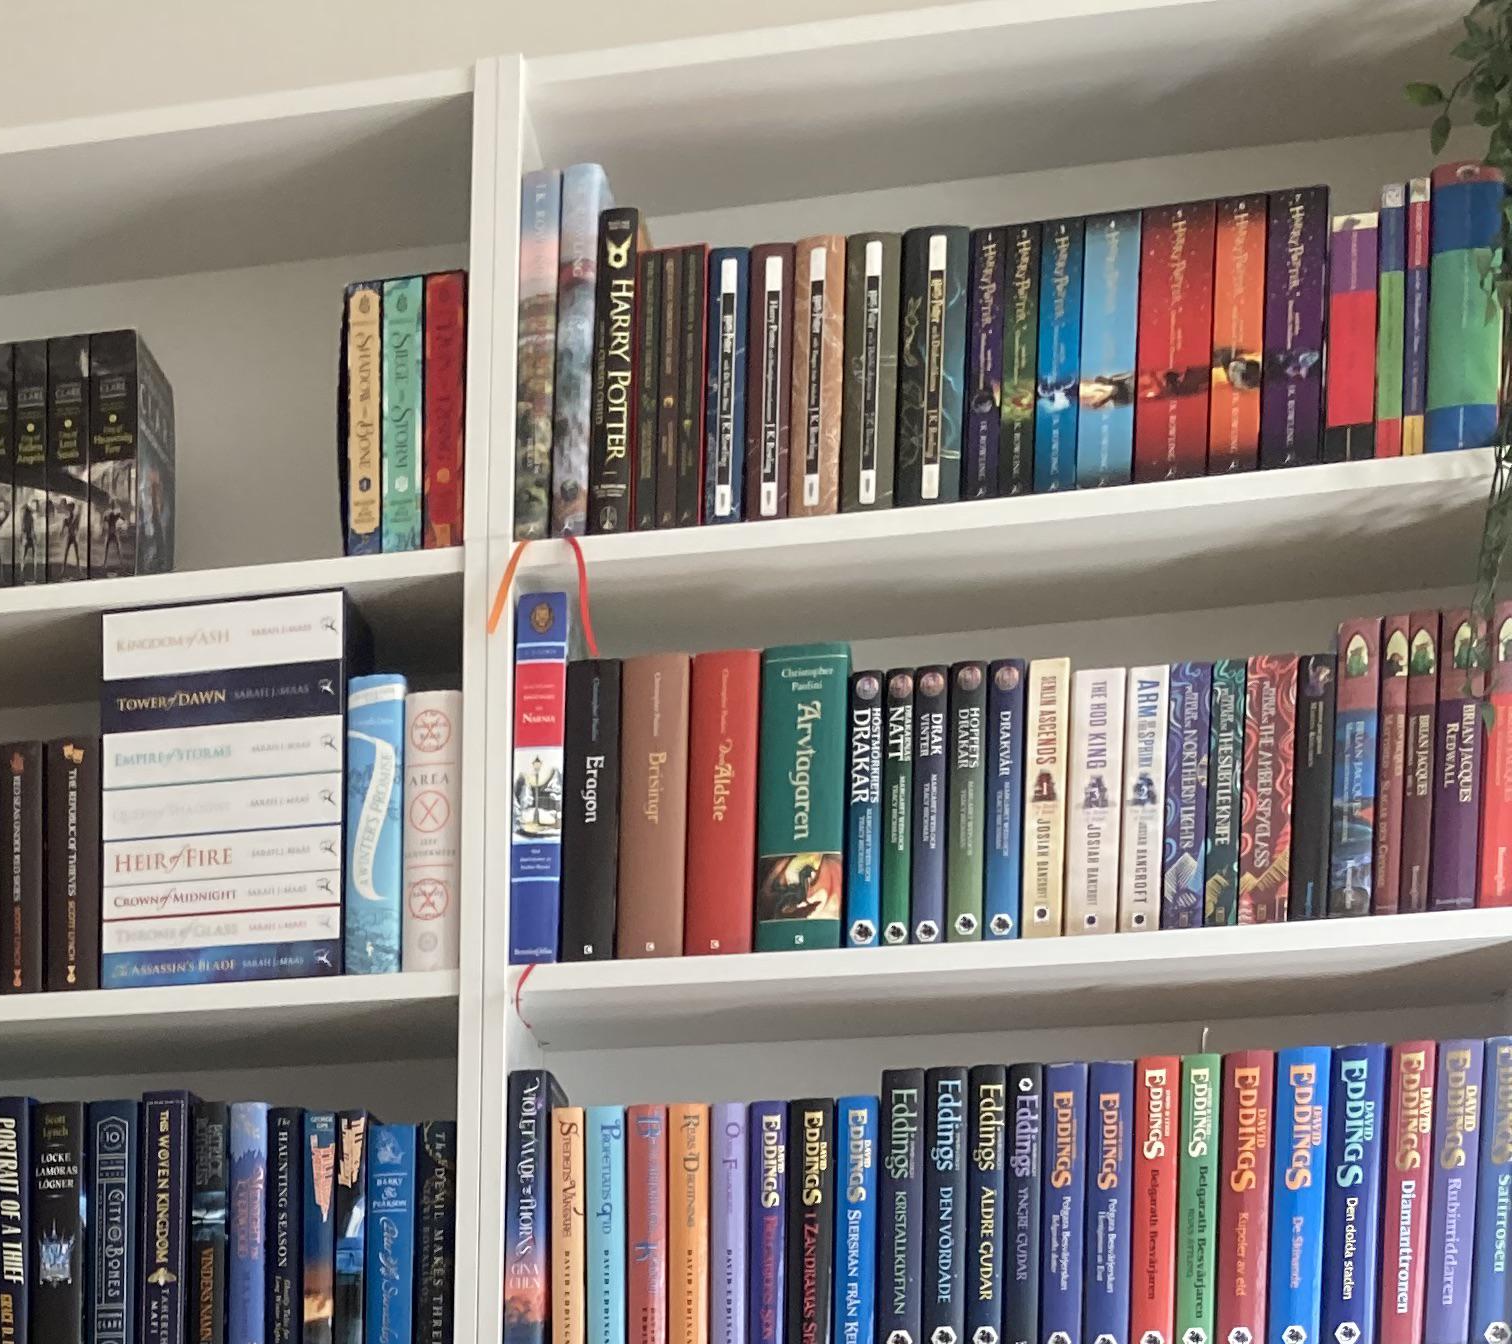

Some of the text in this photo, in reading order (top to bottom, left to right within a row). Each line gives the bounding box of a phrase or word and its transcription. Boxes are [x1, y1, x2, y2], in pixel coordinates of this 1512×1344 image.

[605, 279, 634, 463] HARRY POTTER
[117, 698, 169, 713] TOWER
[179, 691, 226, 708] DAWN
[888, 707, 903, 762] NATT
[1087, 682, 1107, 771] THE HOD KING
[789, 701, 822, 841] Arvtagaren
[851, 708, 871, 806] DRAKAR
[957, 708, 969, 770] DRAKAR
[968, 708, 980, 770] HOPPETS
[998, 711, 1013, 777] DRAKVÅR
[1036, 711, 1056, 766] ASCENDS
[1443, 723, 1459, 788] REDWALL
[1457, 705, 1476, 803] BRIAN JACQUES
[581, 756, 604, 824] Eragon
[643, 752, 667, 825] Brisingr
[1179, 729, 1197, 849] NORTHERN LIGHTS
[1253, 725, 1273, 869] THE AMBER SPYGLASS
[114, 856, 168, 874] HEIR
[187, 850, 233, 867] FIRE
[846, 1108, 867, 1204] EDDINGS
[931, 1079, 962, 1170] Eddings
[157, 1134, 169, 1190] WOVEN
[974, 1084, 1004, 1300] Eddings ÄLDRE GUDAR
[1337, 1059, 1368, 1300] EDDINGS Den dolda staden
[0, 1200, 19, 1221] OF
[2, 1224, 20, 1235] A
[156, 1192, 170, 1264] KINGDOM
[885, 1088, 917, 1315] Eddings KRISTALLKLYFTAN
[939, 1186, 953, 1220] DEN
[2, 1241, 24, 1284] THIEF
[846, 1209, 862, 1277] SIERSKAN
[1397, 1180, 1416, 1314] Diamanttronen
